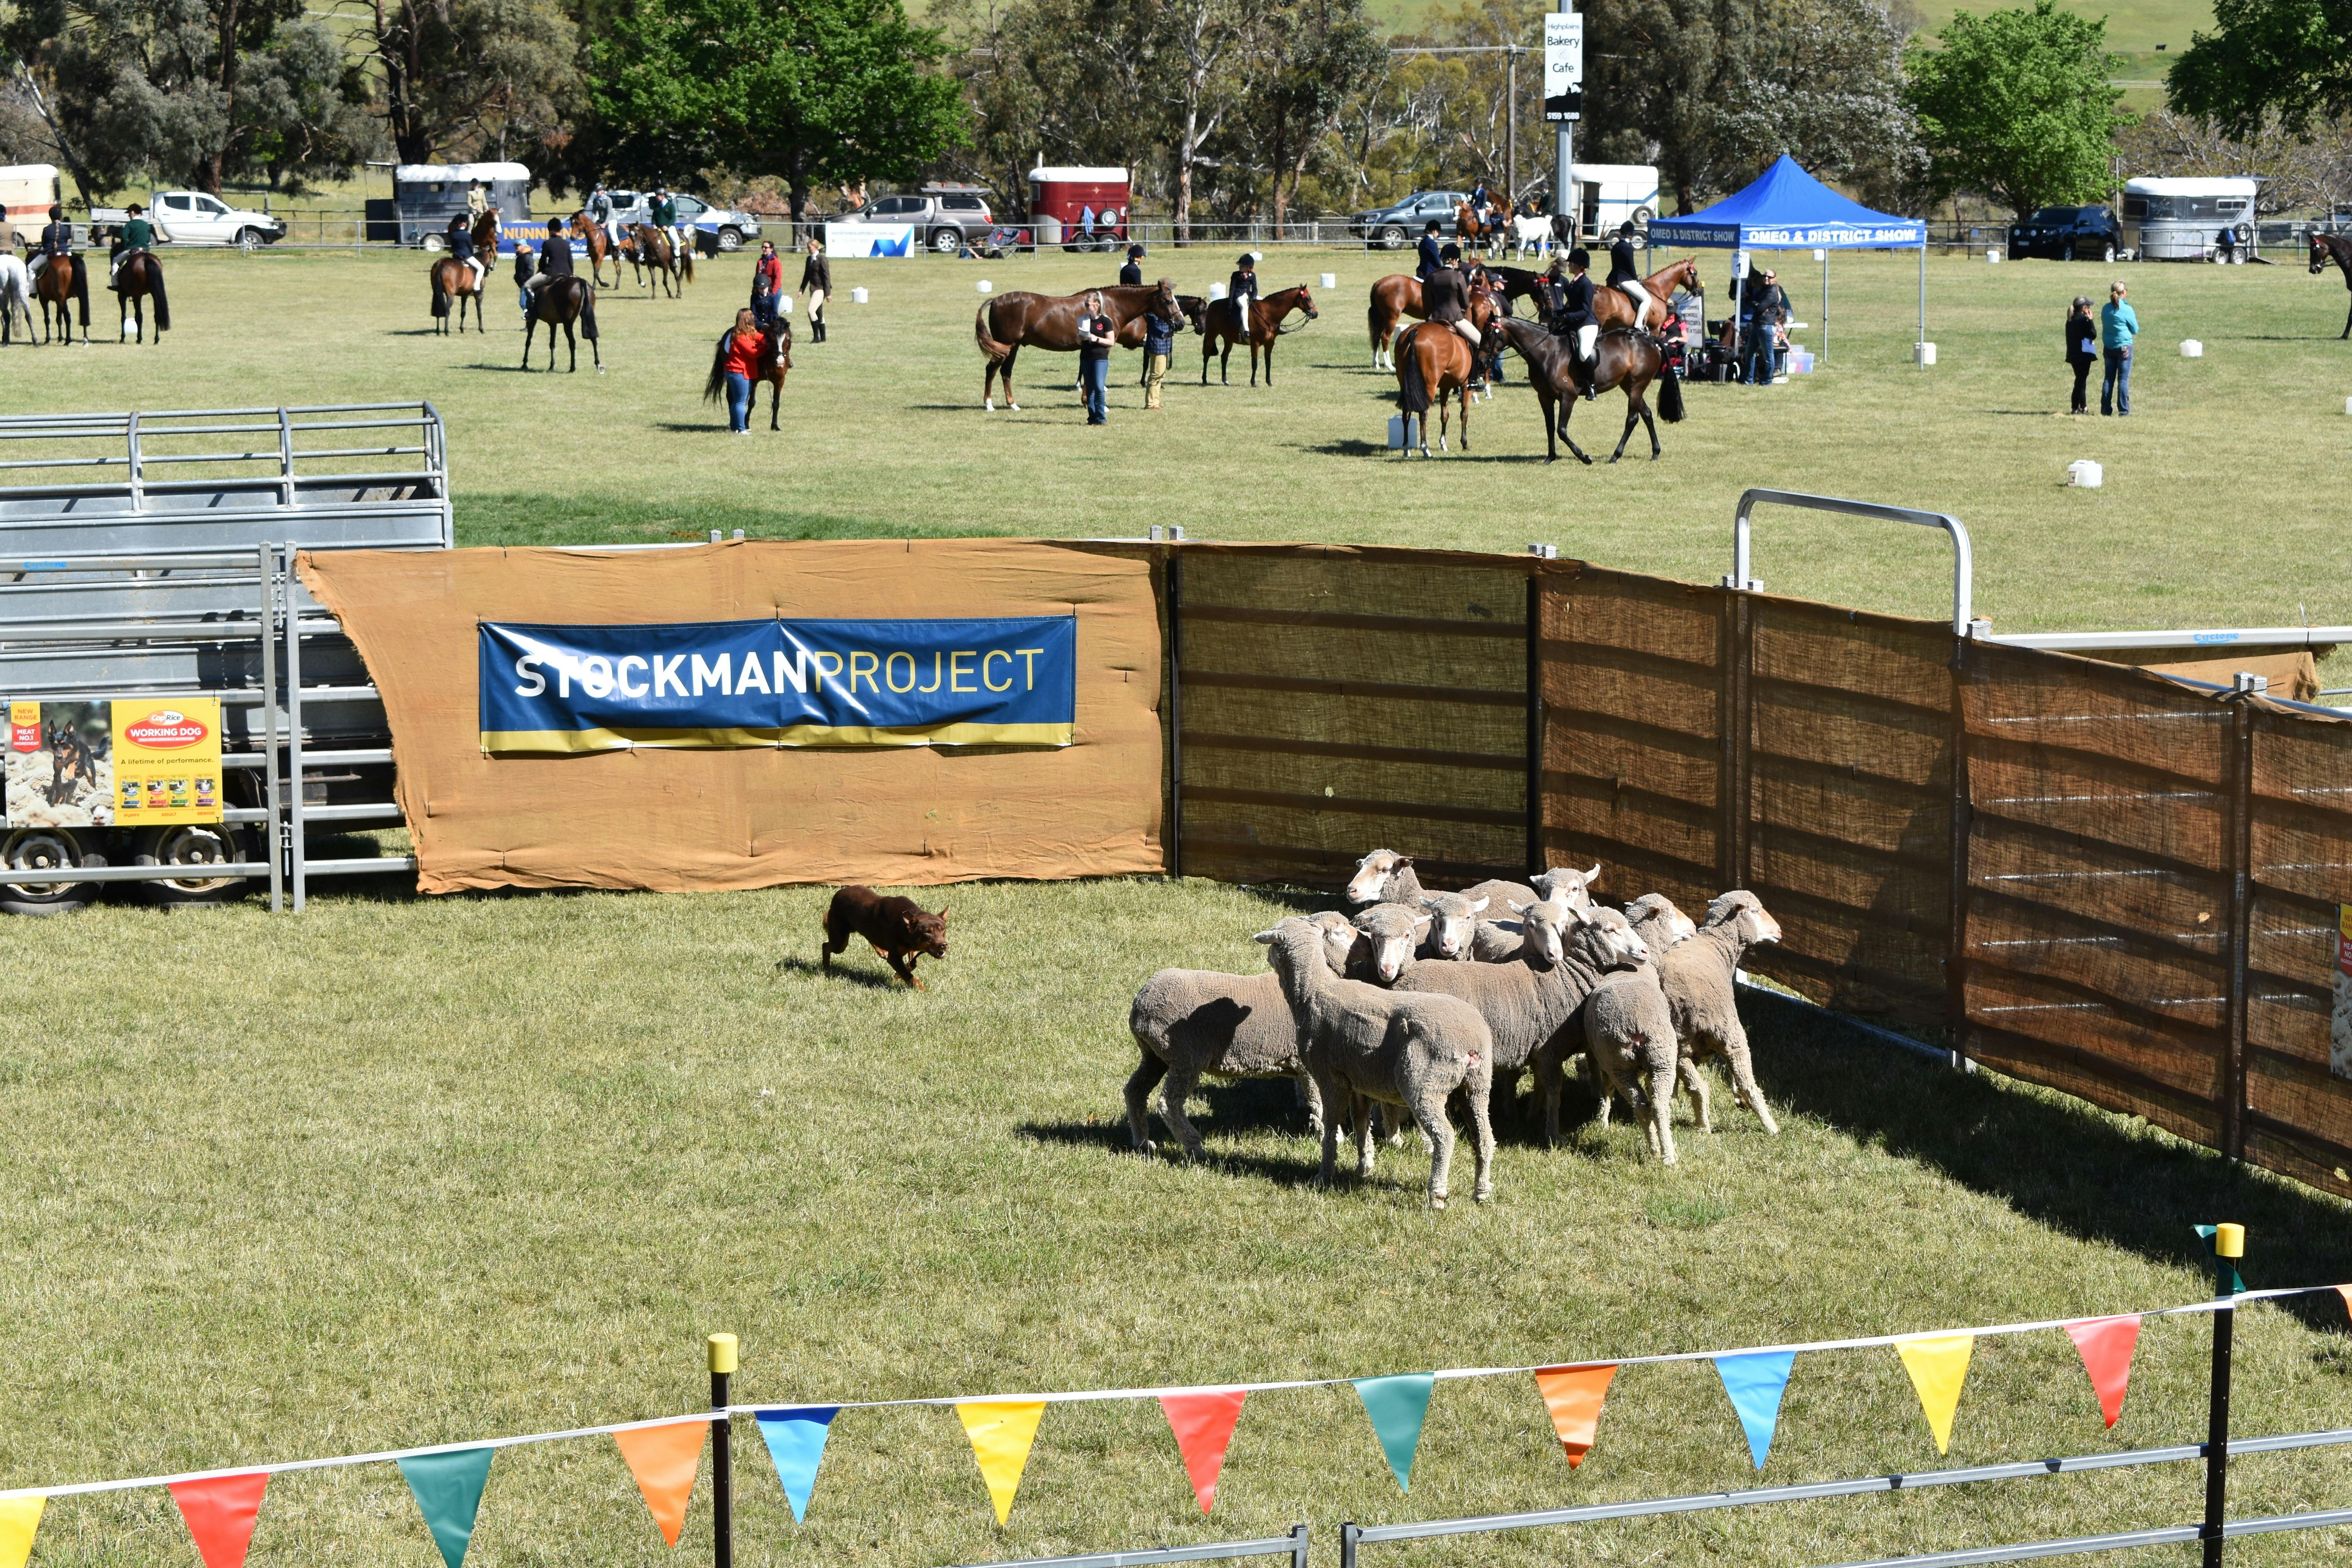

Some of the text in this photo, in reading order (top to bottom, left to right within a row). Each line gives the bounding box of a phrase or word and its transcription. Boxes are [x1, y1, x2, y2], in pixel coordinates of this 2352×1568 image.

[1548, 36, 1579, 48] Bakery
[1553, 63, 1574, 73] Cafe
[504, 227, 586, 240] NUNNIN
[1651, 229, 1735, 241] OMEO & DISTRICT SHOW
[1749, 229, 1916, 243] OMEO & DISTRICT SHOW
[1736, 263, 1741, 273] 1
[2193, 633, 2239, 644] Cyclone
[130, 727, 201, 737] WORKING DOG
[2342, 922, 2352, 931] RAN
[2343, 942, 2352, 950] MEA
